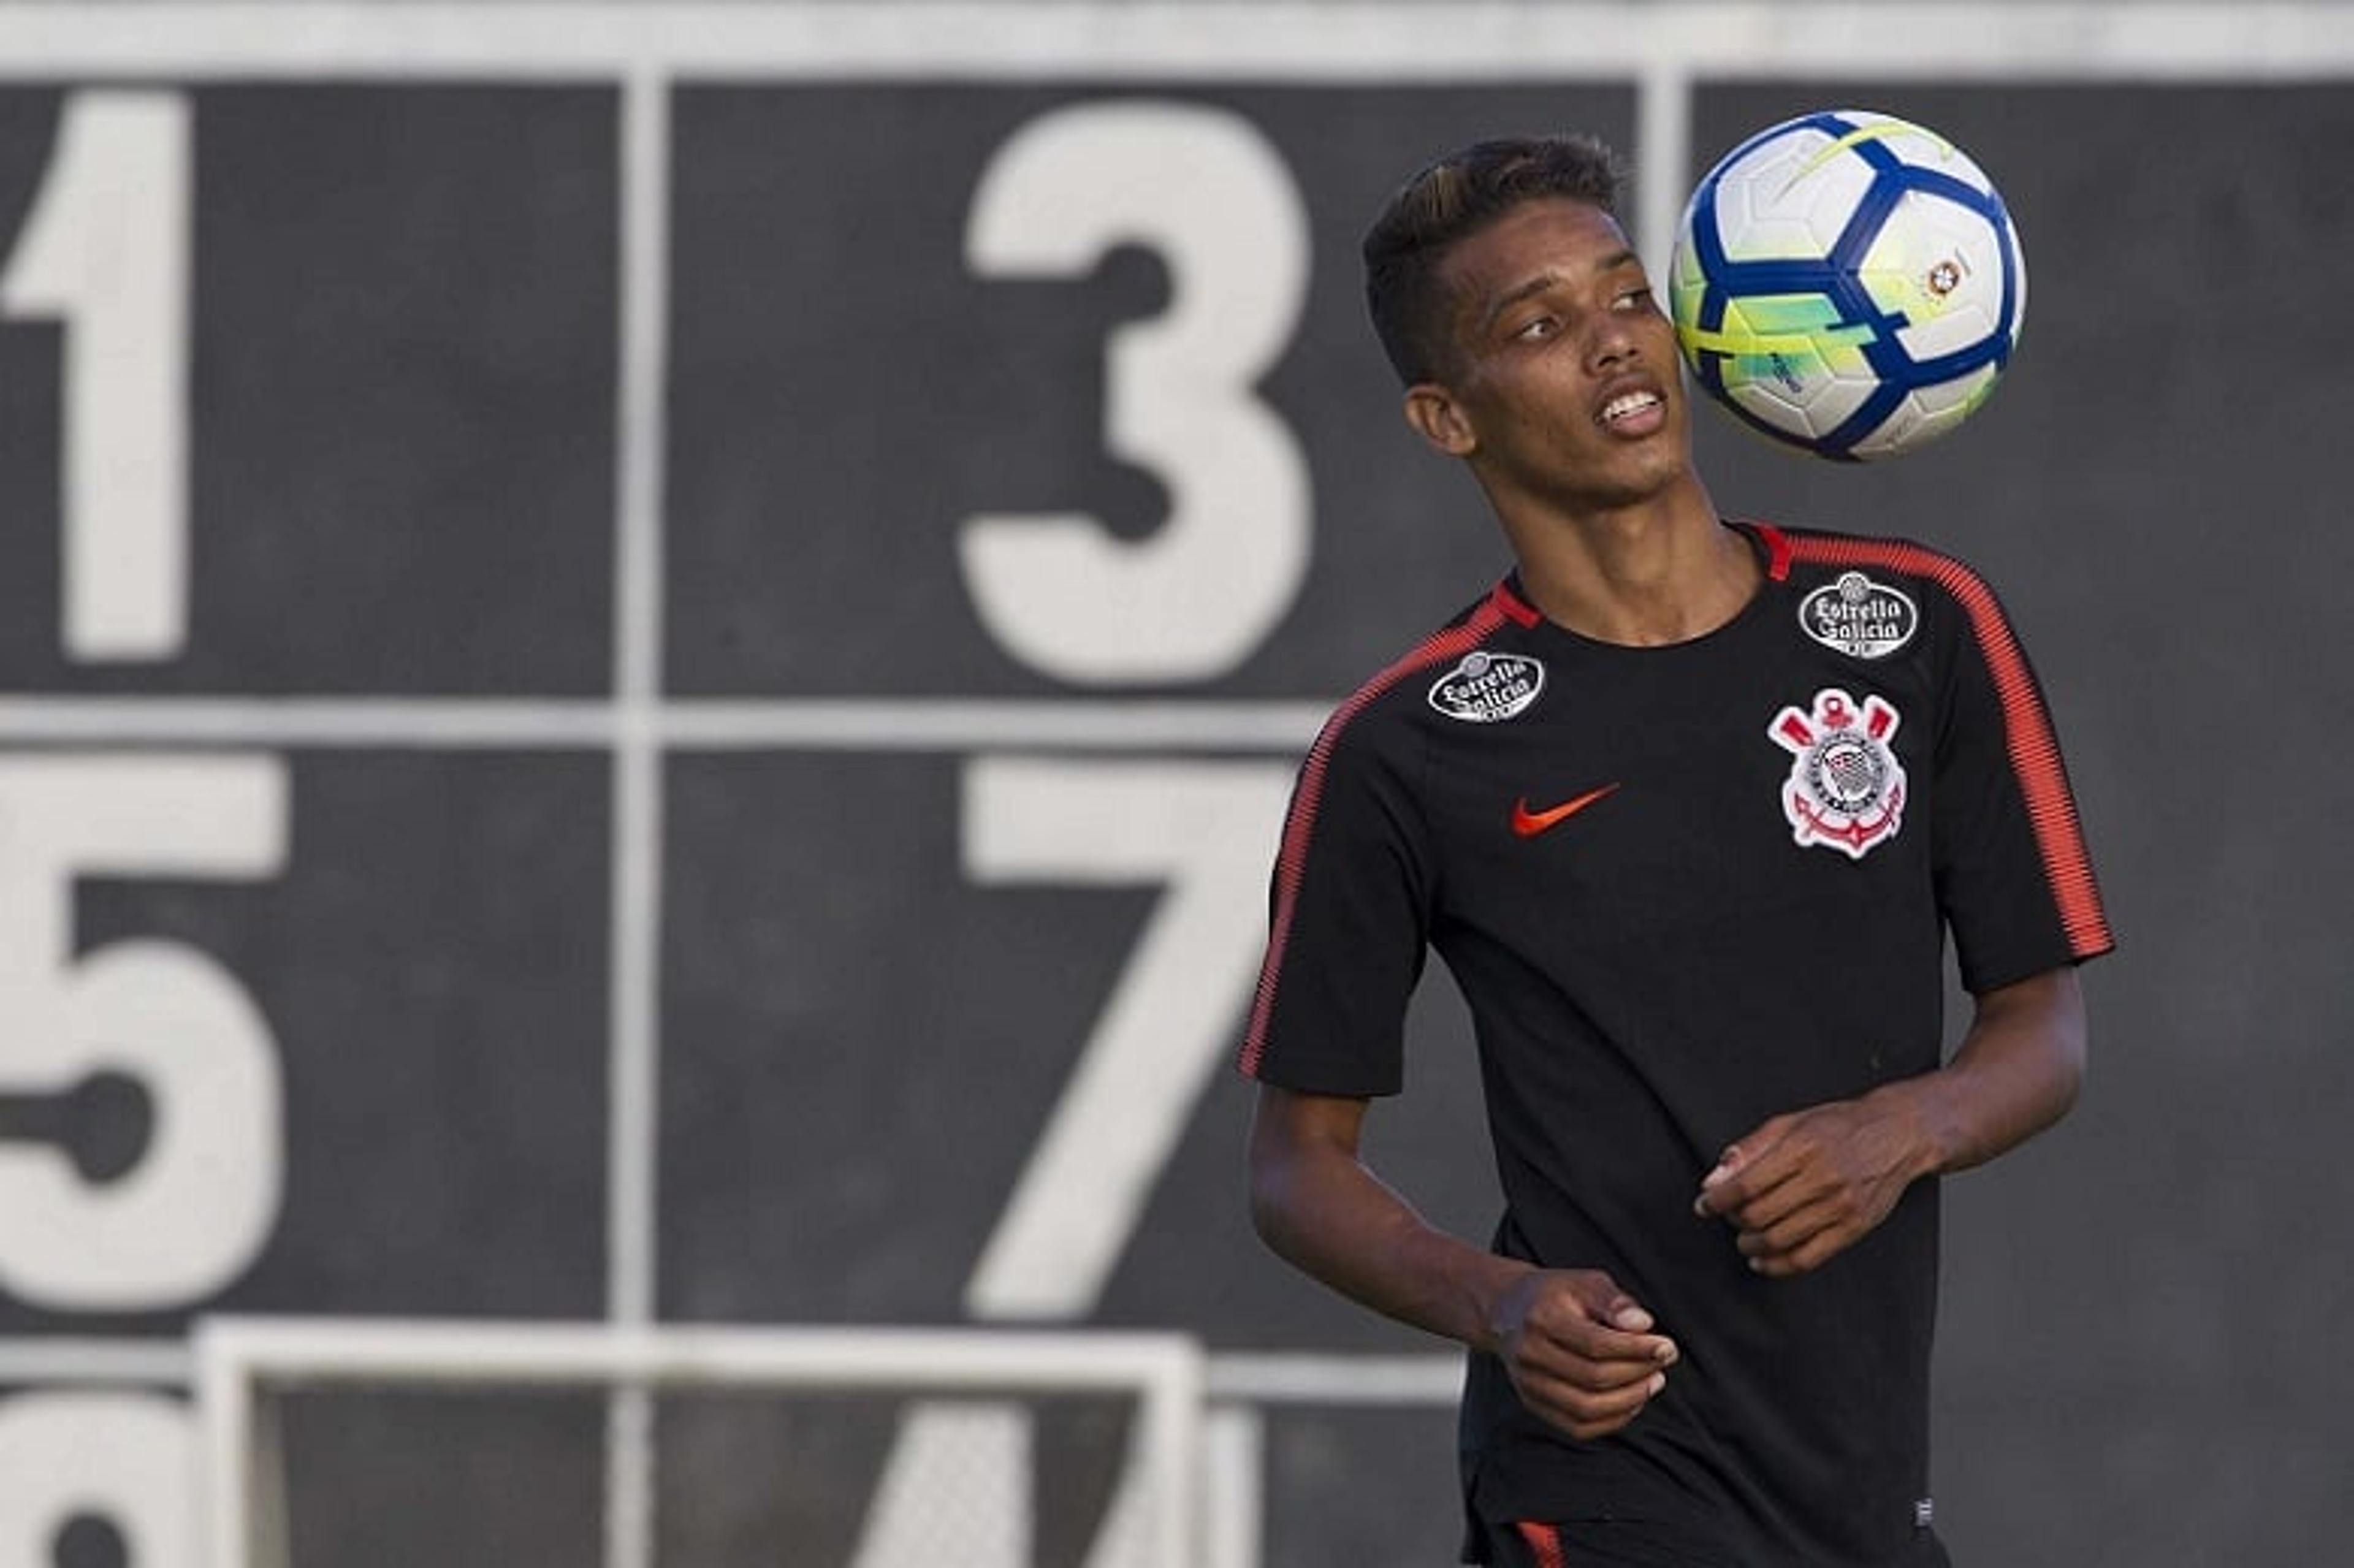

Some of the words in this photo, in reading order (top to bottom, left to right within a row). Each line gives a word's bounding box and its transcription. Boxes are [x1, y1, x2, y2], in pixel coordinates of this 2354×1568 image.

[0, 89, 191, 660] 1
[960, 103, 1311, 683] 3
[1815, 597, 1901, 619] Estrella
[1819, 618, 1899, 639] Galicia
[0, 752, 288, 1310] 5
[962, 756, 1298, 1320] 7
